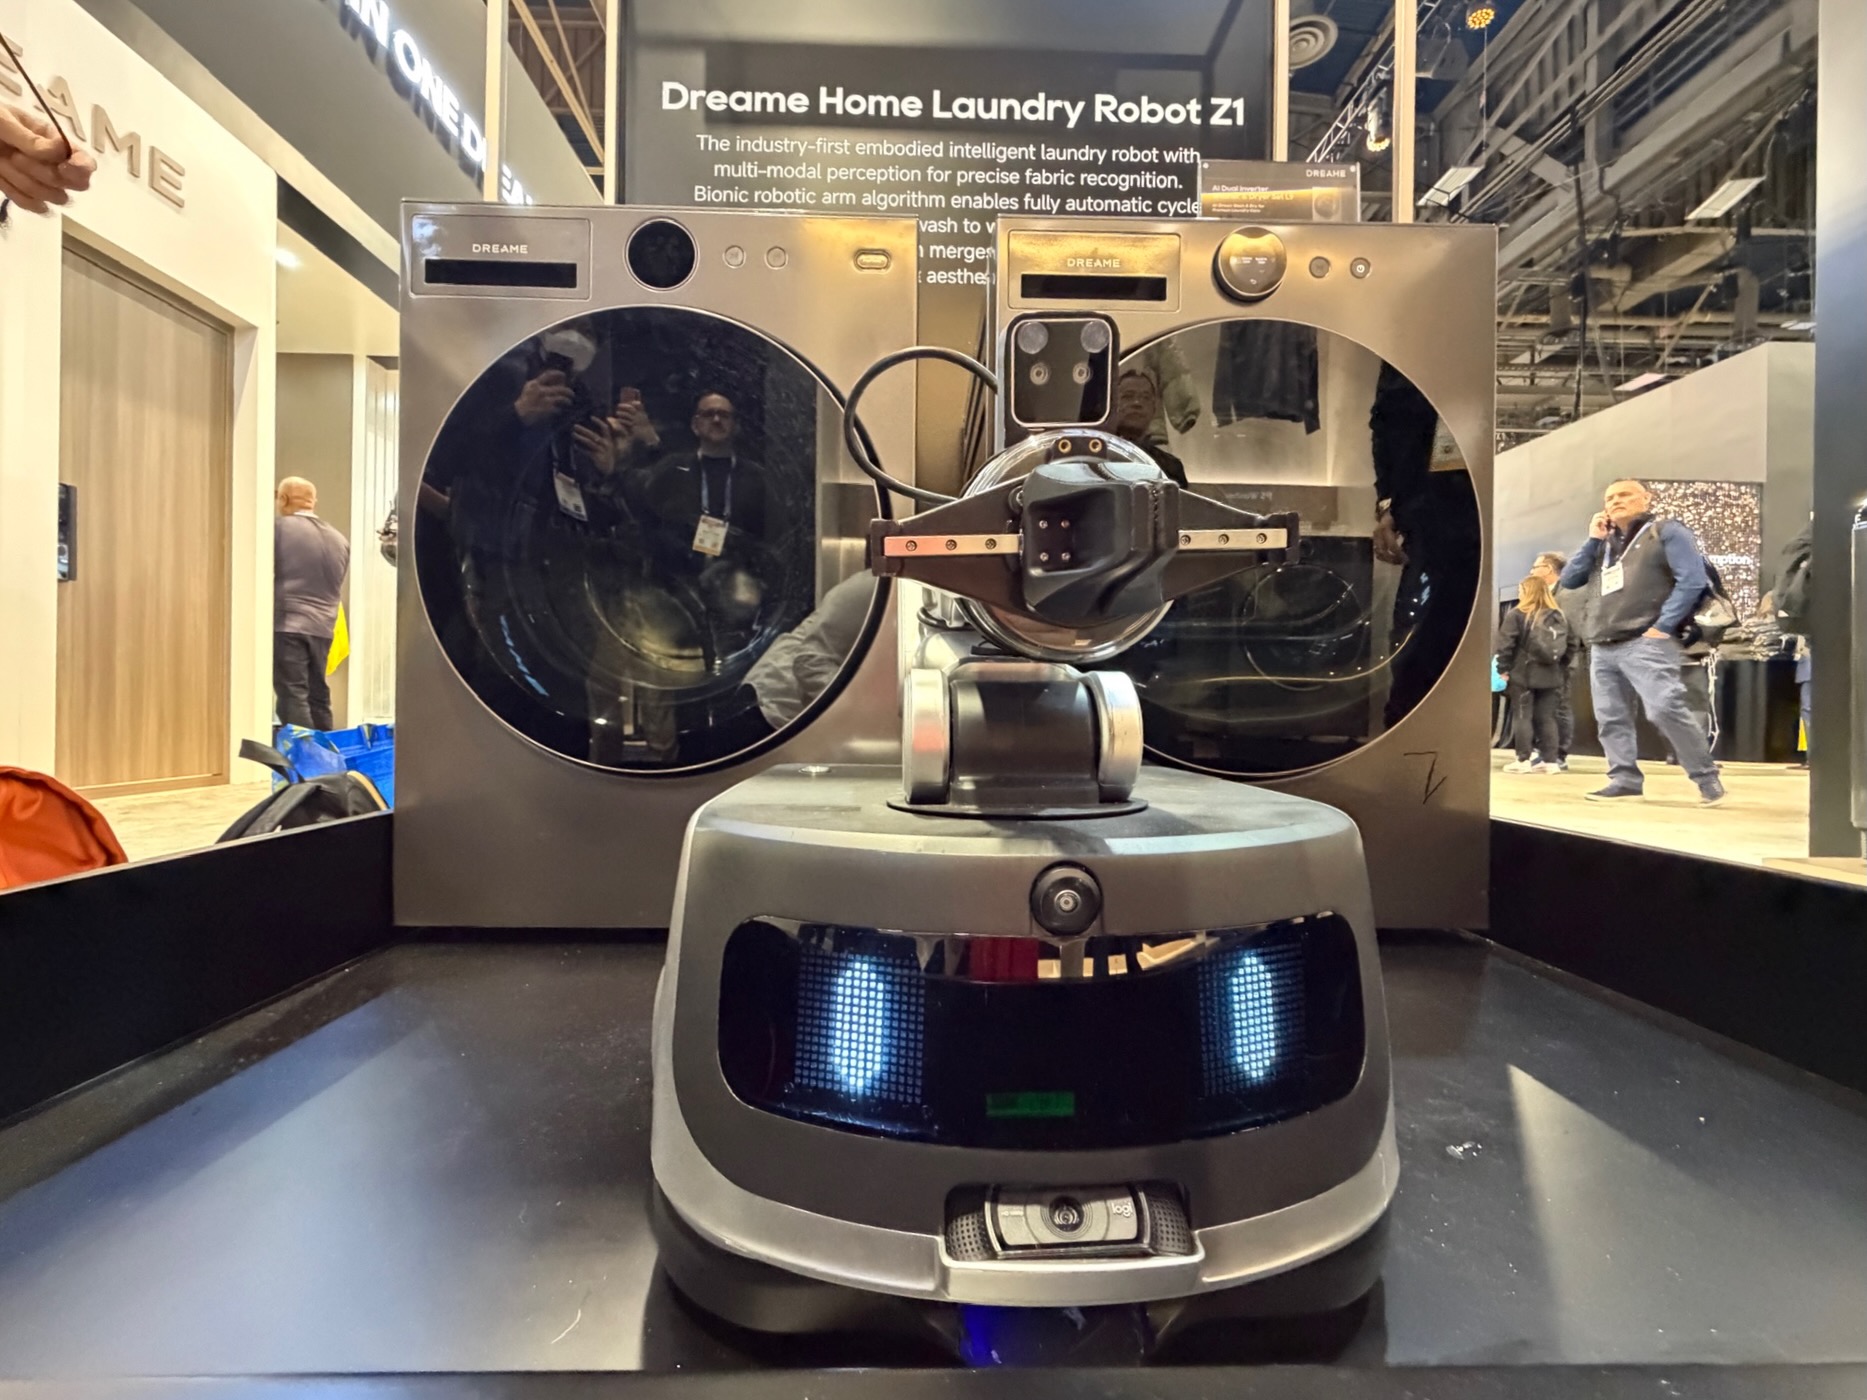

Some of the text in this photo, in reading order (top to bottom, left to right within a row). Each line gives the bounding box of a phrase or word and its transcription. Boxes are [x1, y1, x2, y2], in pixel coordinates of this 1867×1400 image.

[393, 29, 460, 137] ONE
[662, 81, 1244, 128] Dreame Home Laundry Robot Z1
[696, 134, 1200, 165] The industry-first embodied intelligent laundry robot with
[713, 161, 1183, 190] multi-modal perception for precise fabric recognition.
[694, 185, 1200, 217] Bionic robotic arm algorithm enables fully automatic cycle
[963, 218, 981, 234] to
[472, 243, 528, 254] DREAME
[1067, 258, 1121, 268] DREAME
[1112, 1202, 1133, 1218] logi
